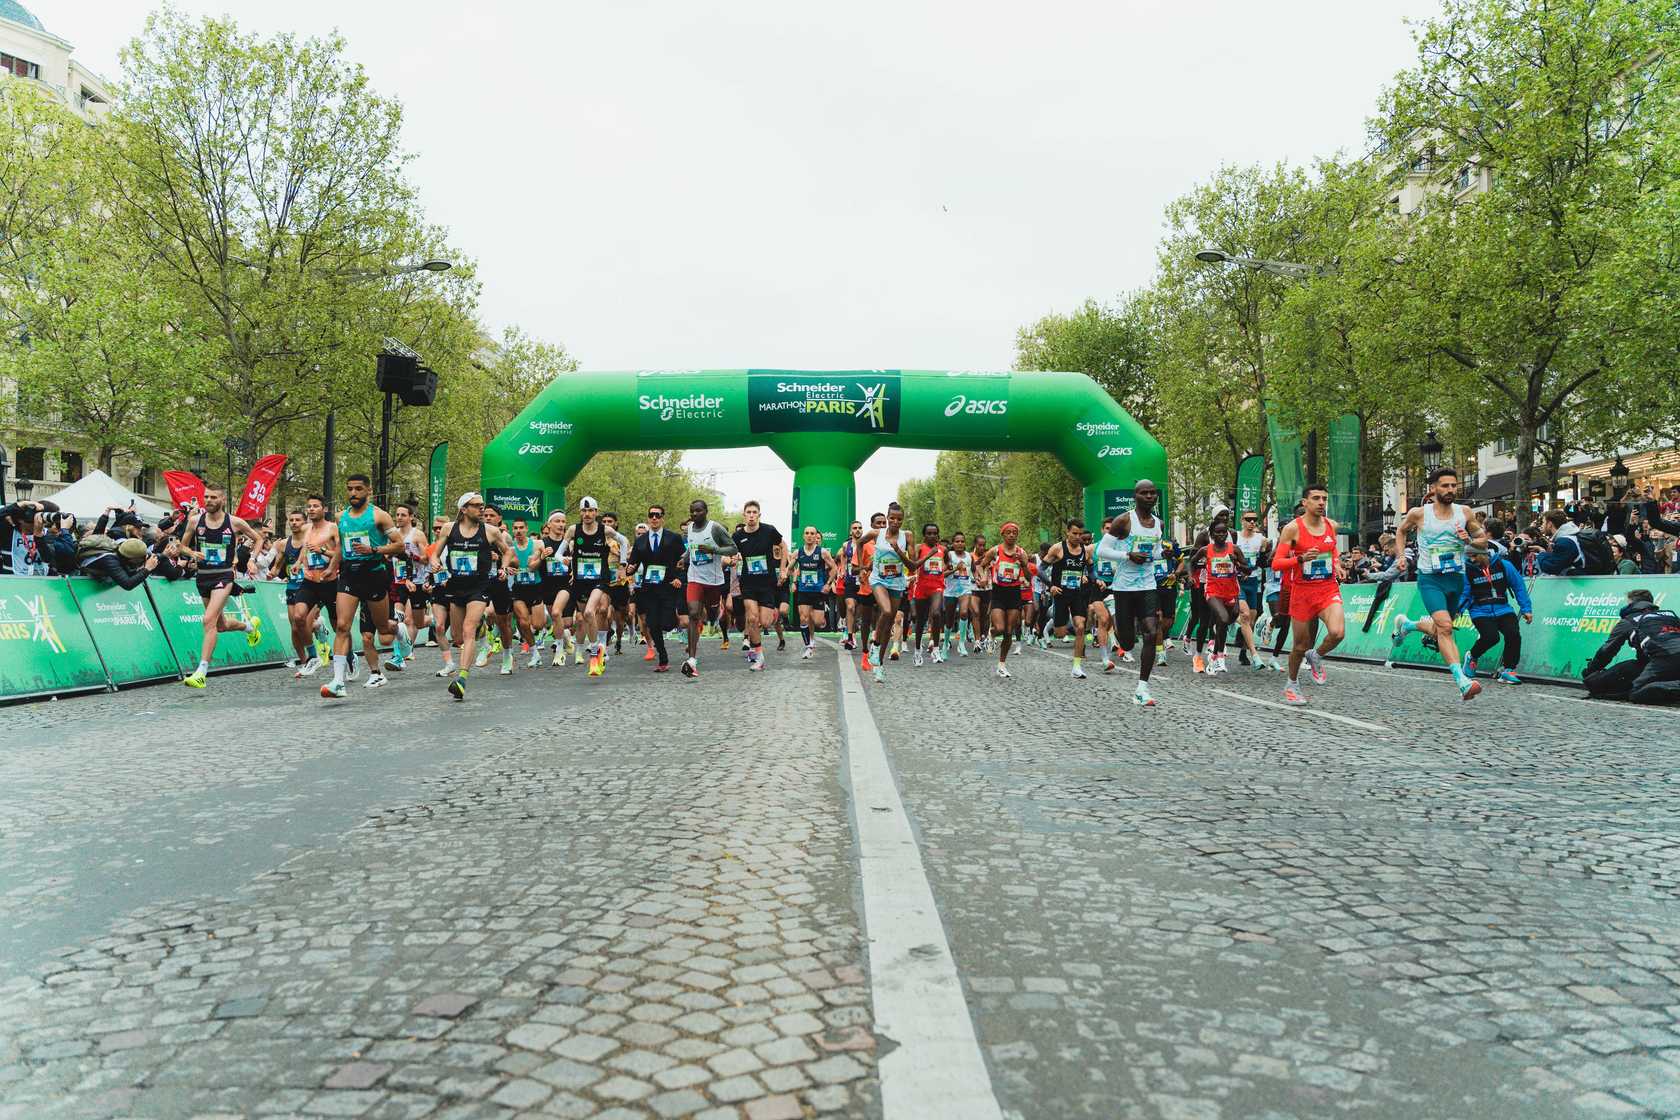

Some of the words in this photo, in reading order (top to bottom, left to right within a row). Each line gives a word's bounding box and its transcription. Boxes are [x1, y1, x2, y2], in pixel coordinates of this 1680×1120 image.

[777, 382, 846, 393] Schneider
[806, 392, 845, 400] Electric
[639, 393, 725, 411] Schneider
[759, 400, 806, 412] MARATHON
[806, 399, 857, 415] PARIS
[676, 408, 724, 419] Electric
[529, 420, 574, 430] Schneider
[1076, 421, 1120, 431] Schneider
[1564, 592, 1624, 607] Schneider
[1584, 606, 1618, 616] Electric
[1543, 616, 1580, 626] MARATHON
